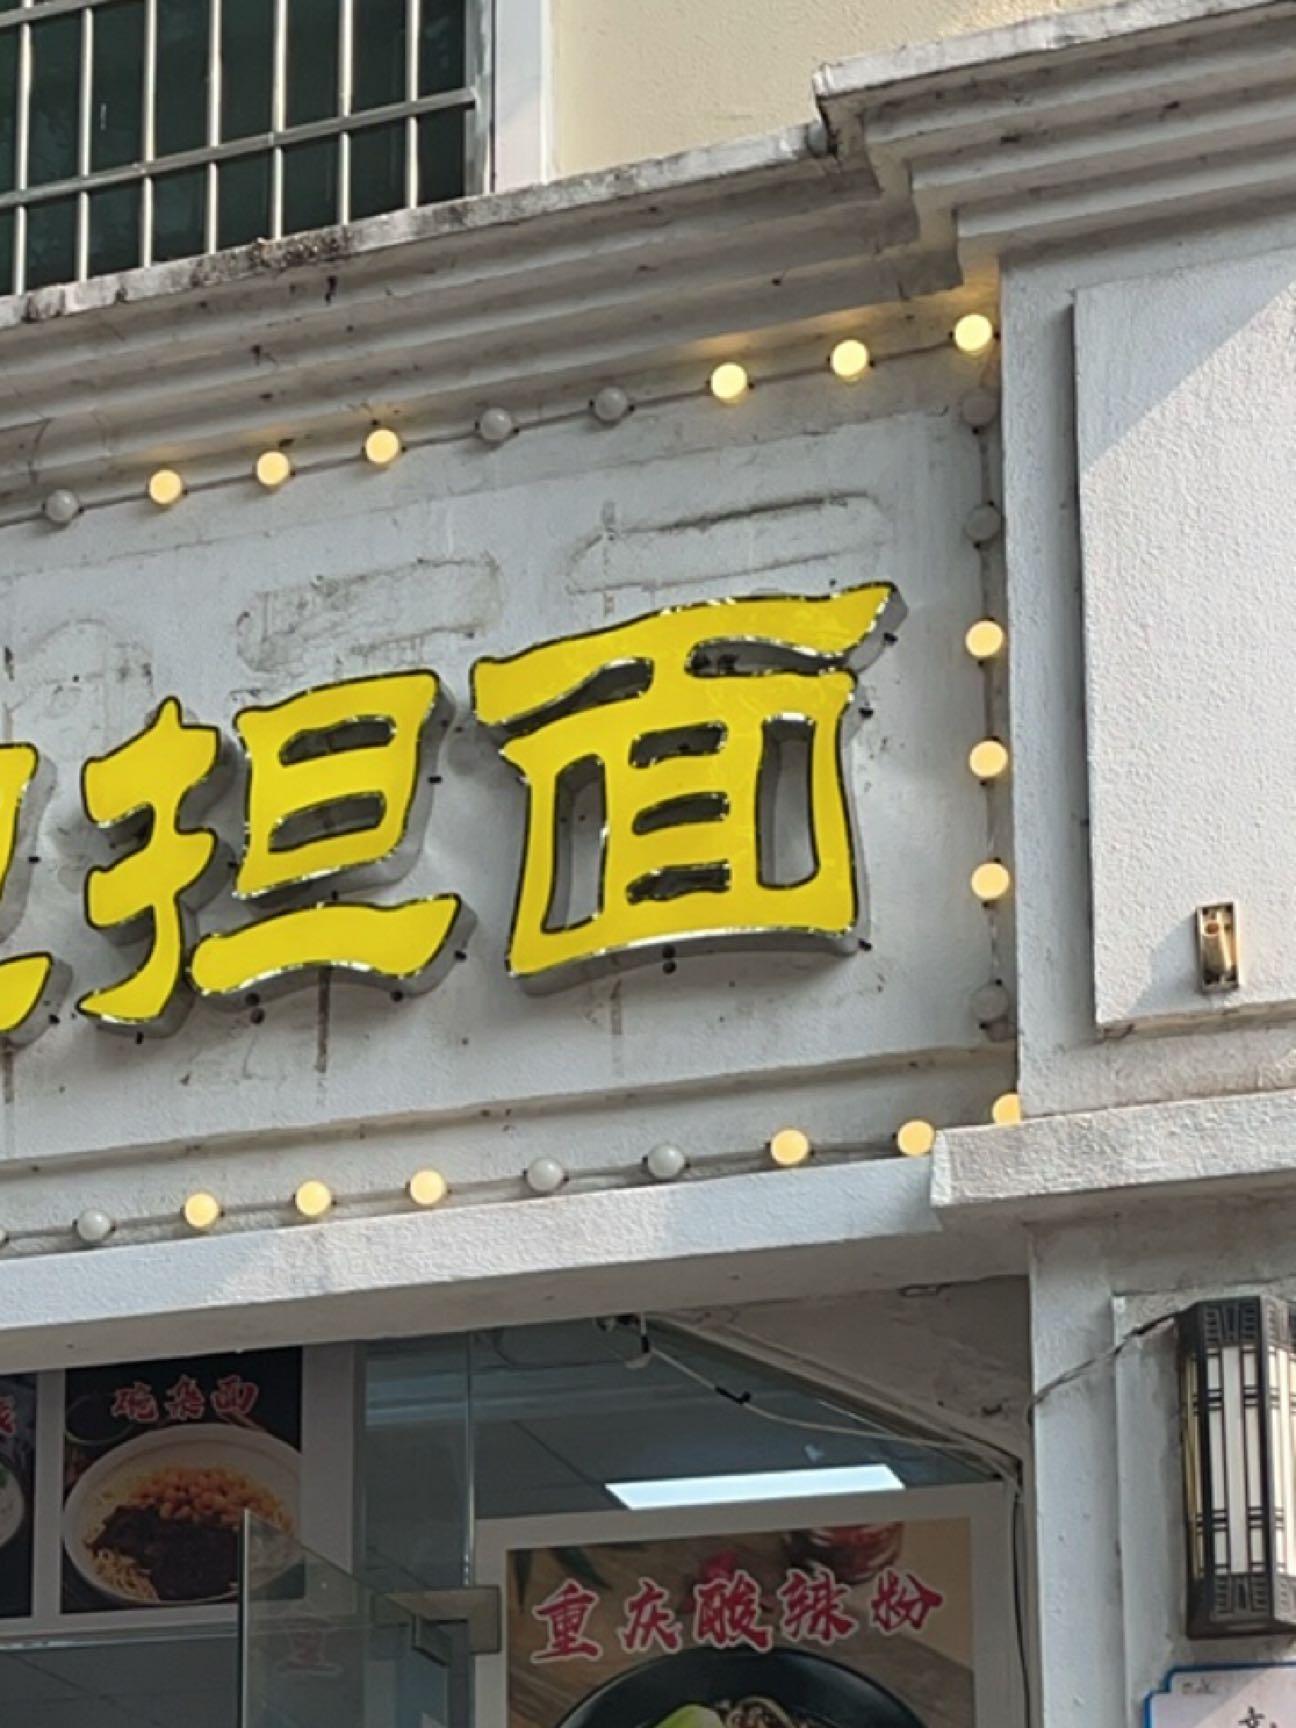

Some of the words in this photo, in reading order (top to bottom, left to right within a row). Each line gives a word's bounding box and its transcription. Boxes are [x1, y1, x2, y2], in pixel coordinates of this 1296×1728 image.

[531, 1568, 947, 1663] 重庆酸辣粉
